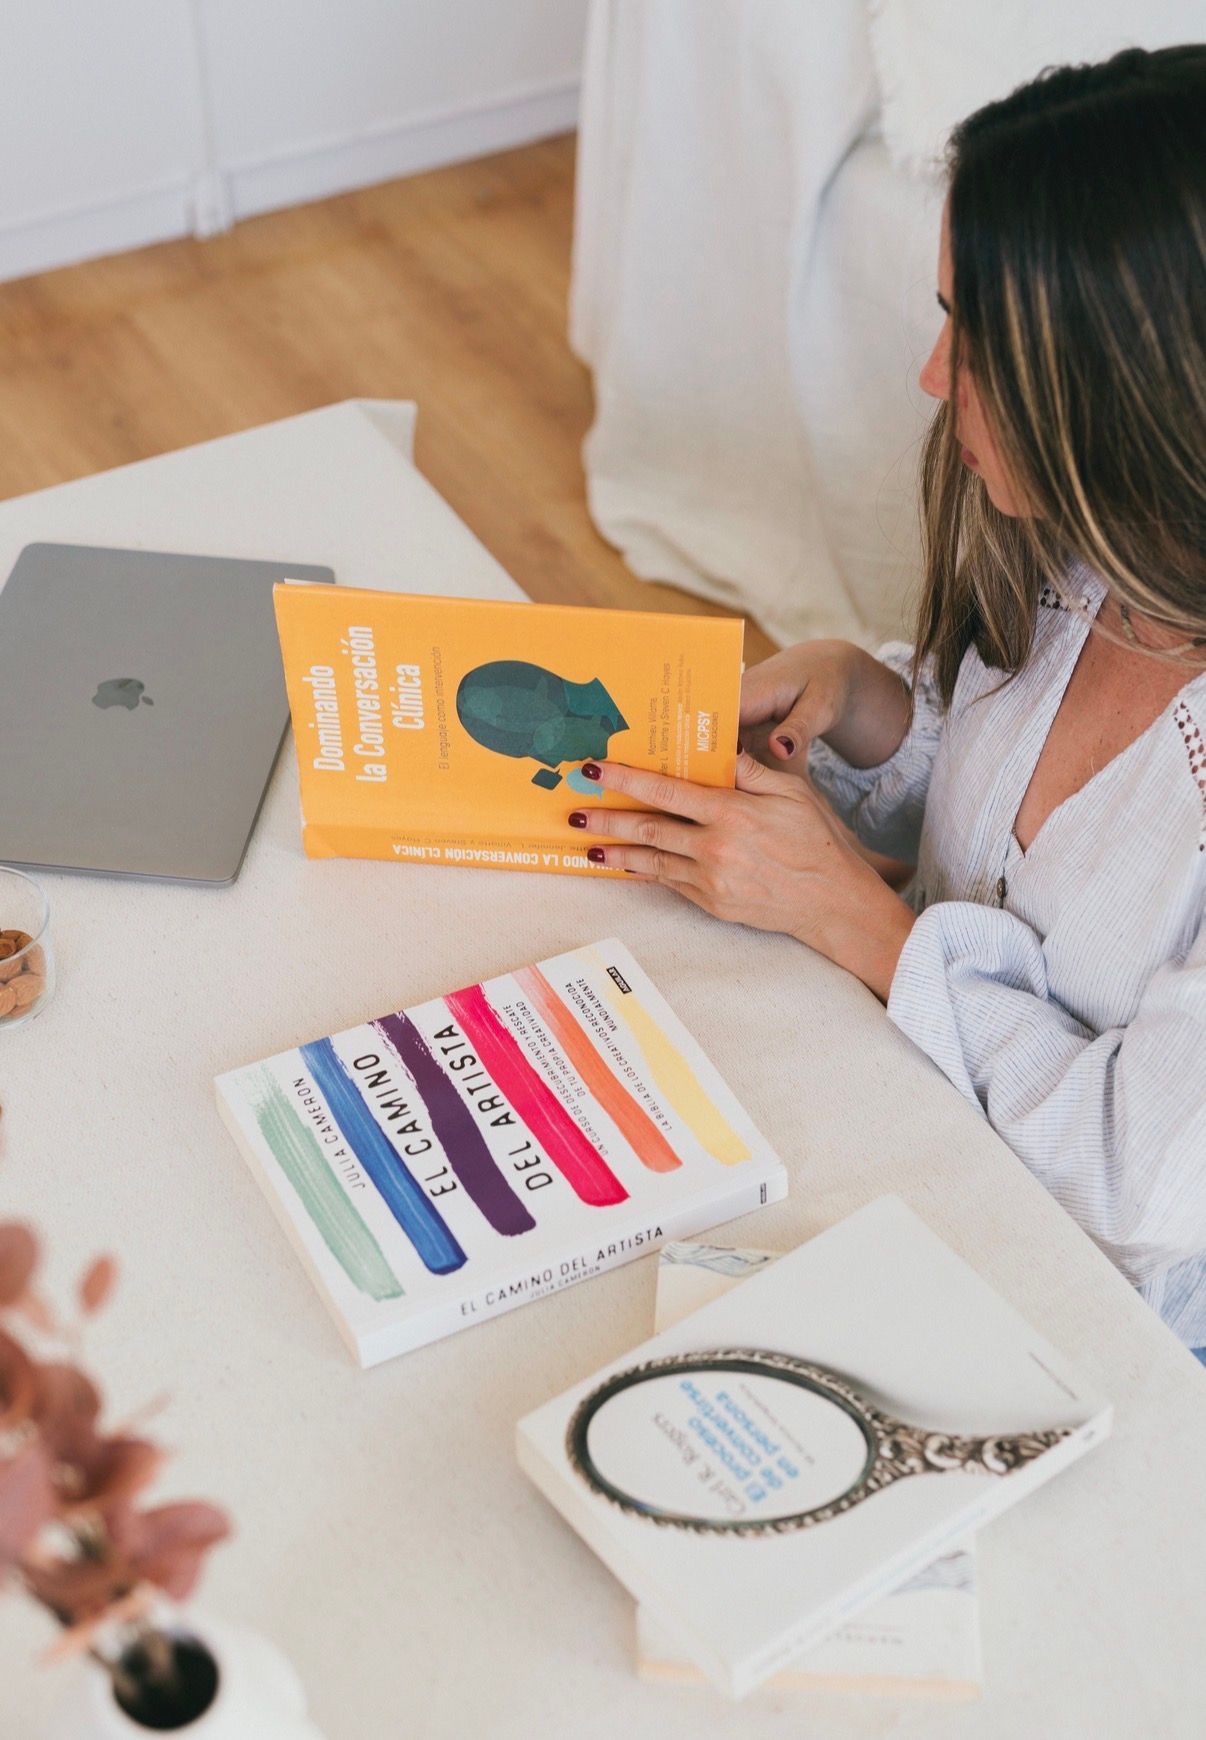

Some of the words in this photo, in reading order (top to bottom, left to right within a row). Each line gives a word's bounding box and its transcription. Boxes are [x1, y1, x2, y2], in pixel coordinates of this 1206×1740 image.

[432, 646, 444, 696] intervención
[340, 626, 385, 757] Conversación
[389, 664, 425, 730] Clínica
[302, 665, 345, 771] Dominando
[437, 699, 447, 721] como
[438, 723, 450, 760] lenguaje
[696, 710, 711, 752] MICPSY
[356, 763, 387, 783] la
[439, 762, 449, 770] El
[392, 844, 440, 859] CLÍNICA
[445, 847, 538, 864] CONVERSACIÓN
[543, 853, 559, 867] LA
[607, 966, 632, 994] AGUILAR
[502, 1004, 527, 1036] RESCATE
[565, 982, 599, 1027] RECONOCIDA
[576, 978, 618, 1032] MUNDIALMENTE
[516, 1001, 551, 1047] CREATIVIDAD
[549, 1047, 570, 1076] PROPIA
[595, 1027, 628, 1067] CREATIVOS
[433, 1024, 516, 1127] ARTISTA
[527, 1040, 575, 1104] DESCUBRIMIENTO
[566, 1075, 576, 1086] TU
[623, 1067, 639, 1082] LOS
[634, 1082, 646, 1093] DE
[353, 1053, 432, 1156] CAMINO
[574, 1086, 586, 1097] DE
[643, 1093, 665, 1121] BIBLIA
[293, 1077, 339, 1144] CAMERON
[570, 1105, 582, 1116] DE
[661, 1121, 672, 1131] LA
[577, 1117, 600, 1144] CURSO
[334, 1148, 365, 1190] JULIA
[424, 1166, 457, 1197] EL
[508, 1140, 553, 1191] DEL
[461, 1301, 477, 1316] EL
[486, 1269, 553, 1306] CAMINO
[559, 1256, 588, 1277] DEL
[596, 1226, 664, 1262] ARTISTA
[653, 1412, 698, 1465] Rogers
[679, 1380, 761, 1466] convertirse
[715, 1391, 780, 1455] persona
[688, 1417, 751, 1480] proceso
[760, 1467, 783, 1489] de
[776, 1457, 800, 1479] en
[745, 1482, 767, 1504] El
